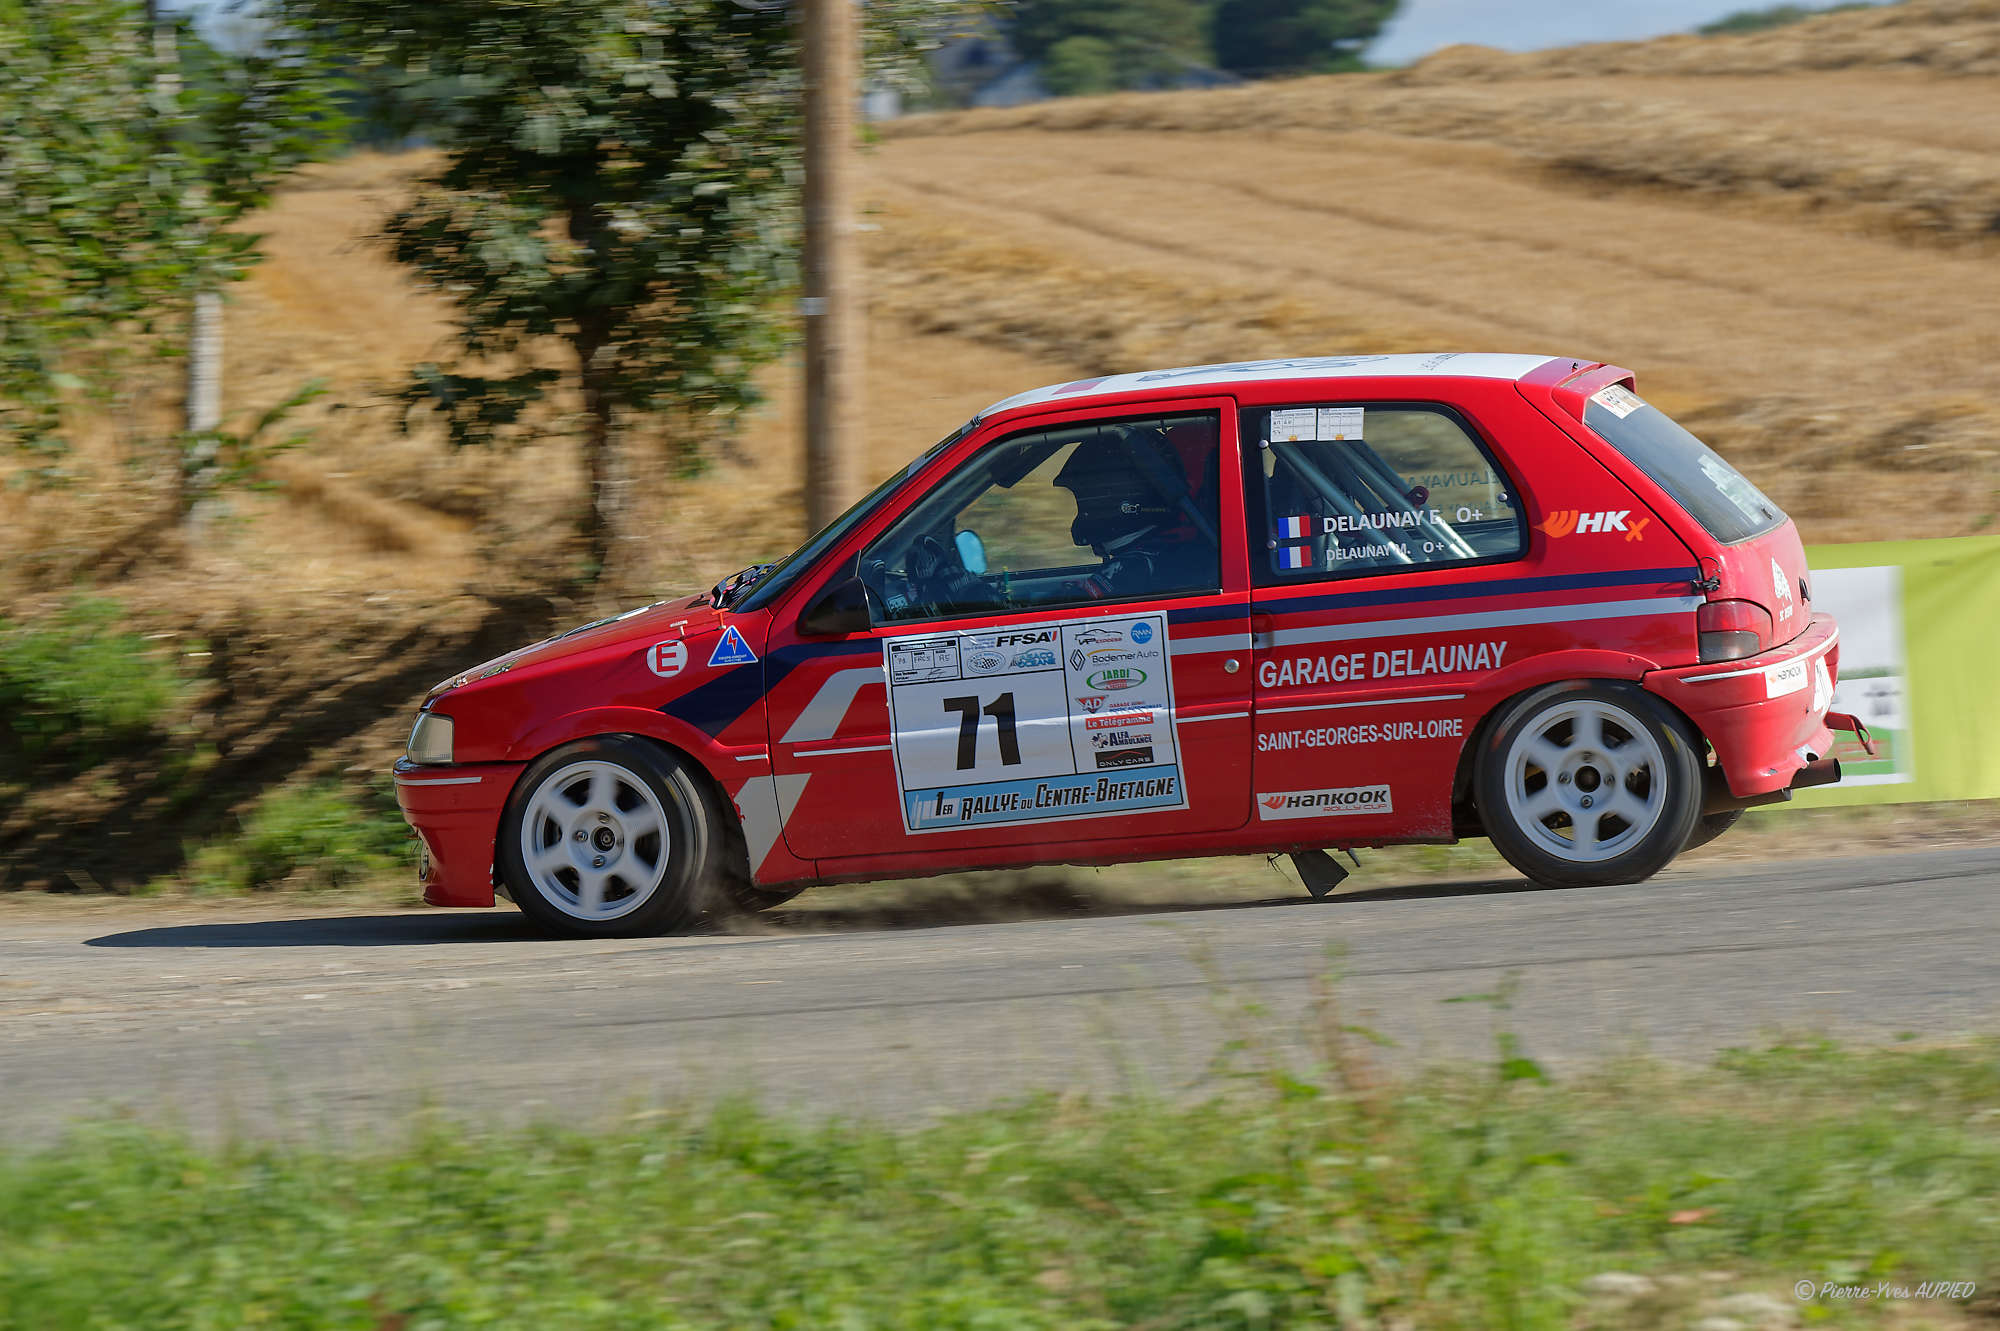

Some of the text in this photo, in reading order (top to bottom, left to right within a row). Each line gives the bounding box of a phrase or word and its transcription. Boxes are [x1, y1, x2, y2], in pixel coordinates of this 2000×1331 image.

[1323, 510, 1424, 533] DELAUNAY
[1456, 506, 1484, 523] O+
[1326, 543, 1390, 562] DELAUNAY
[1423, 541, 1445, 554] O+
[996, 631, 1051, 648] FFSA
[656, 642, 681, 673] E
[1136, 650, 1159, 659] Auto
[1259, 641, 1508, 688] GARAGE DELAUNAY
[943, 691, 1022, 771] 71
[1087, 716, 1152, 729] Le Télégramme
[1258, 718, 1463, 751] SAINT-GEORGES-SUR-LOIRE
[960, 792, 1020, 822] RALLYE
[1035, 776, 1176, 809] CENTRE-BRETAGNE
